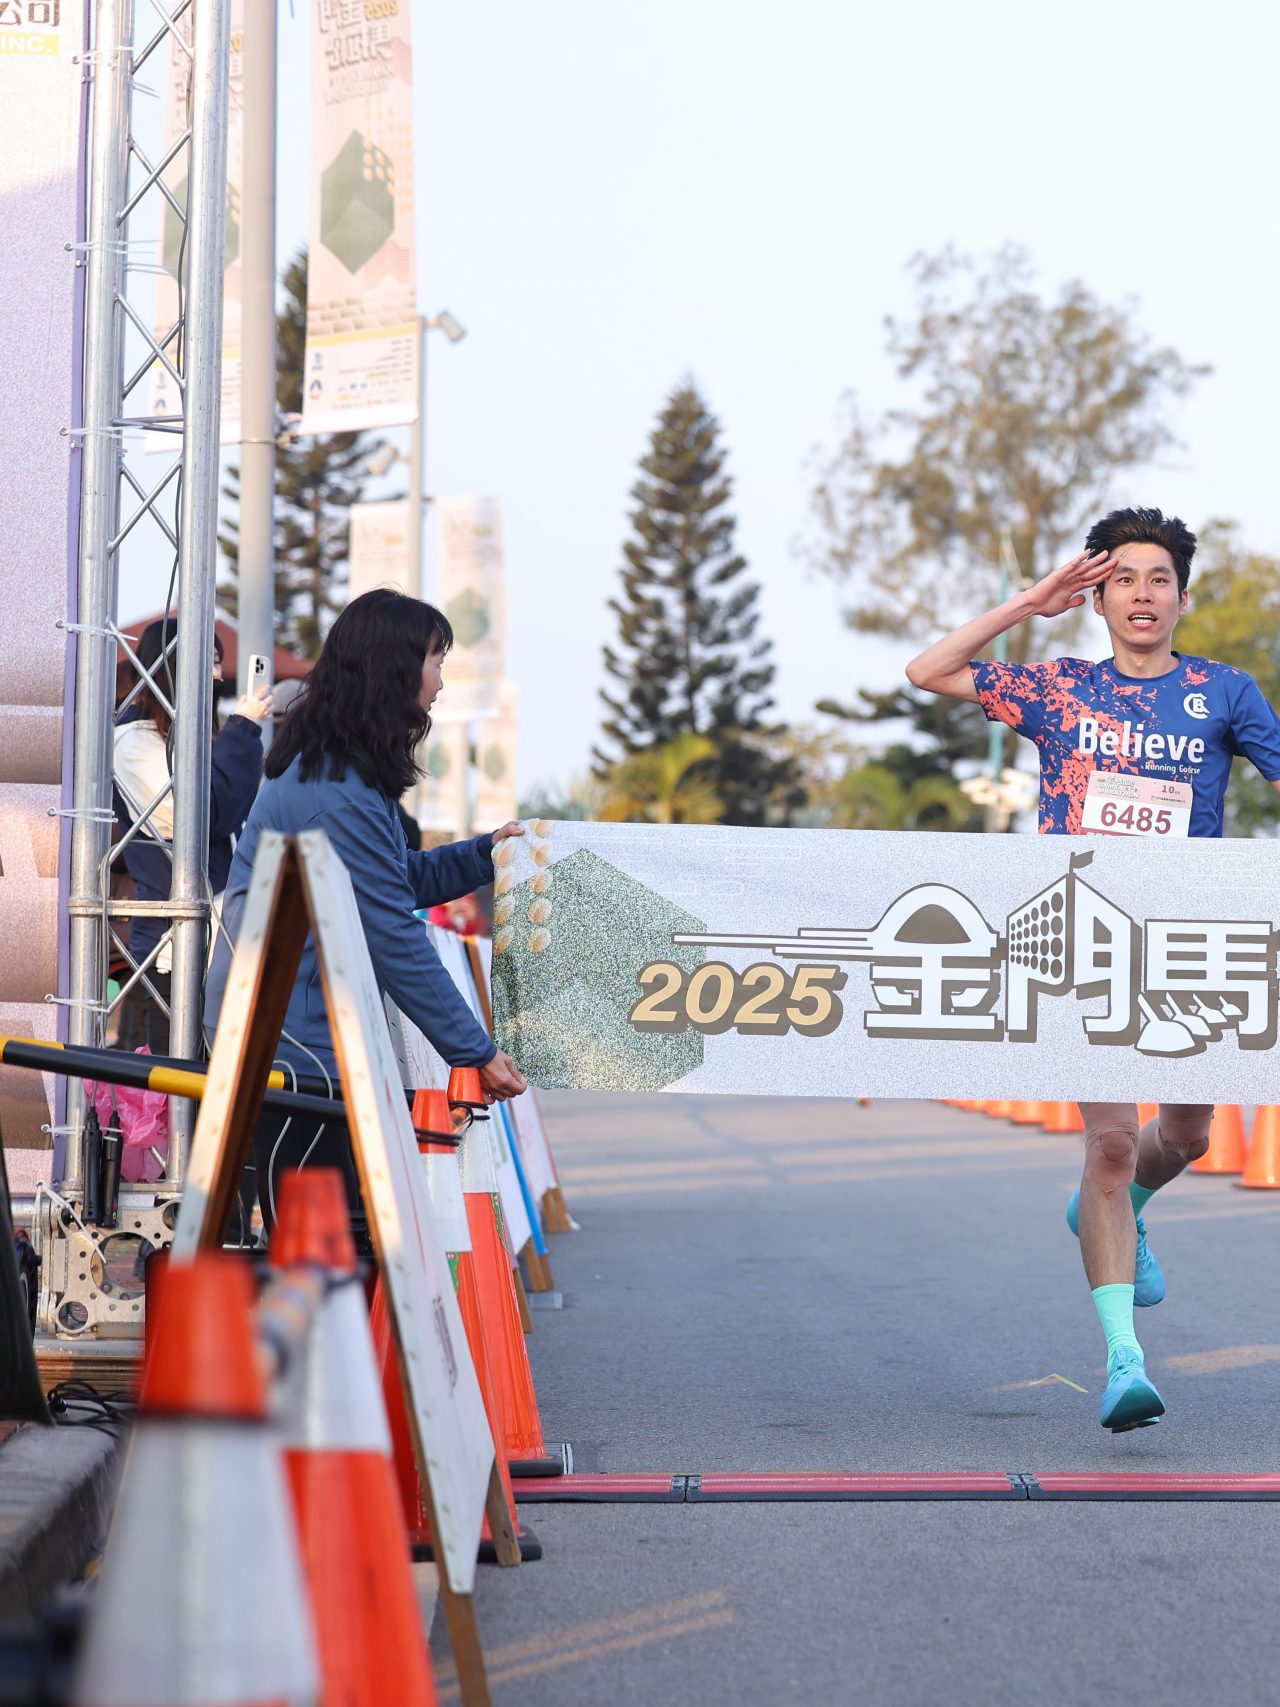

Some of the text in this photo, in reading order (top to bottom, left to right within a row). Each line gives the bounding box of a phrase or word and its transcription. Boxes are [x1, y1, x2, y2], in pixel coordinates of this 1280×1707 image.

[1079, 717, 1205, 763] Believe
[1145, 762, 1200, 775] Running Course
[1161, 784, 1175, 794] 10
[1101, 802, 1172, 834] 6485
[629, 960, 848, 1037] 2025
